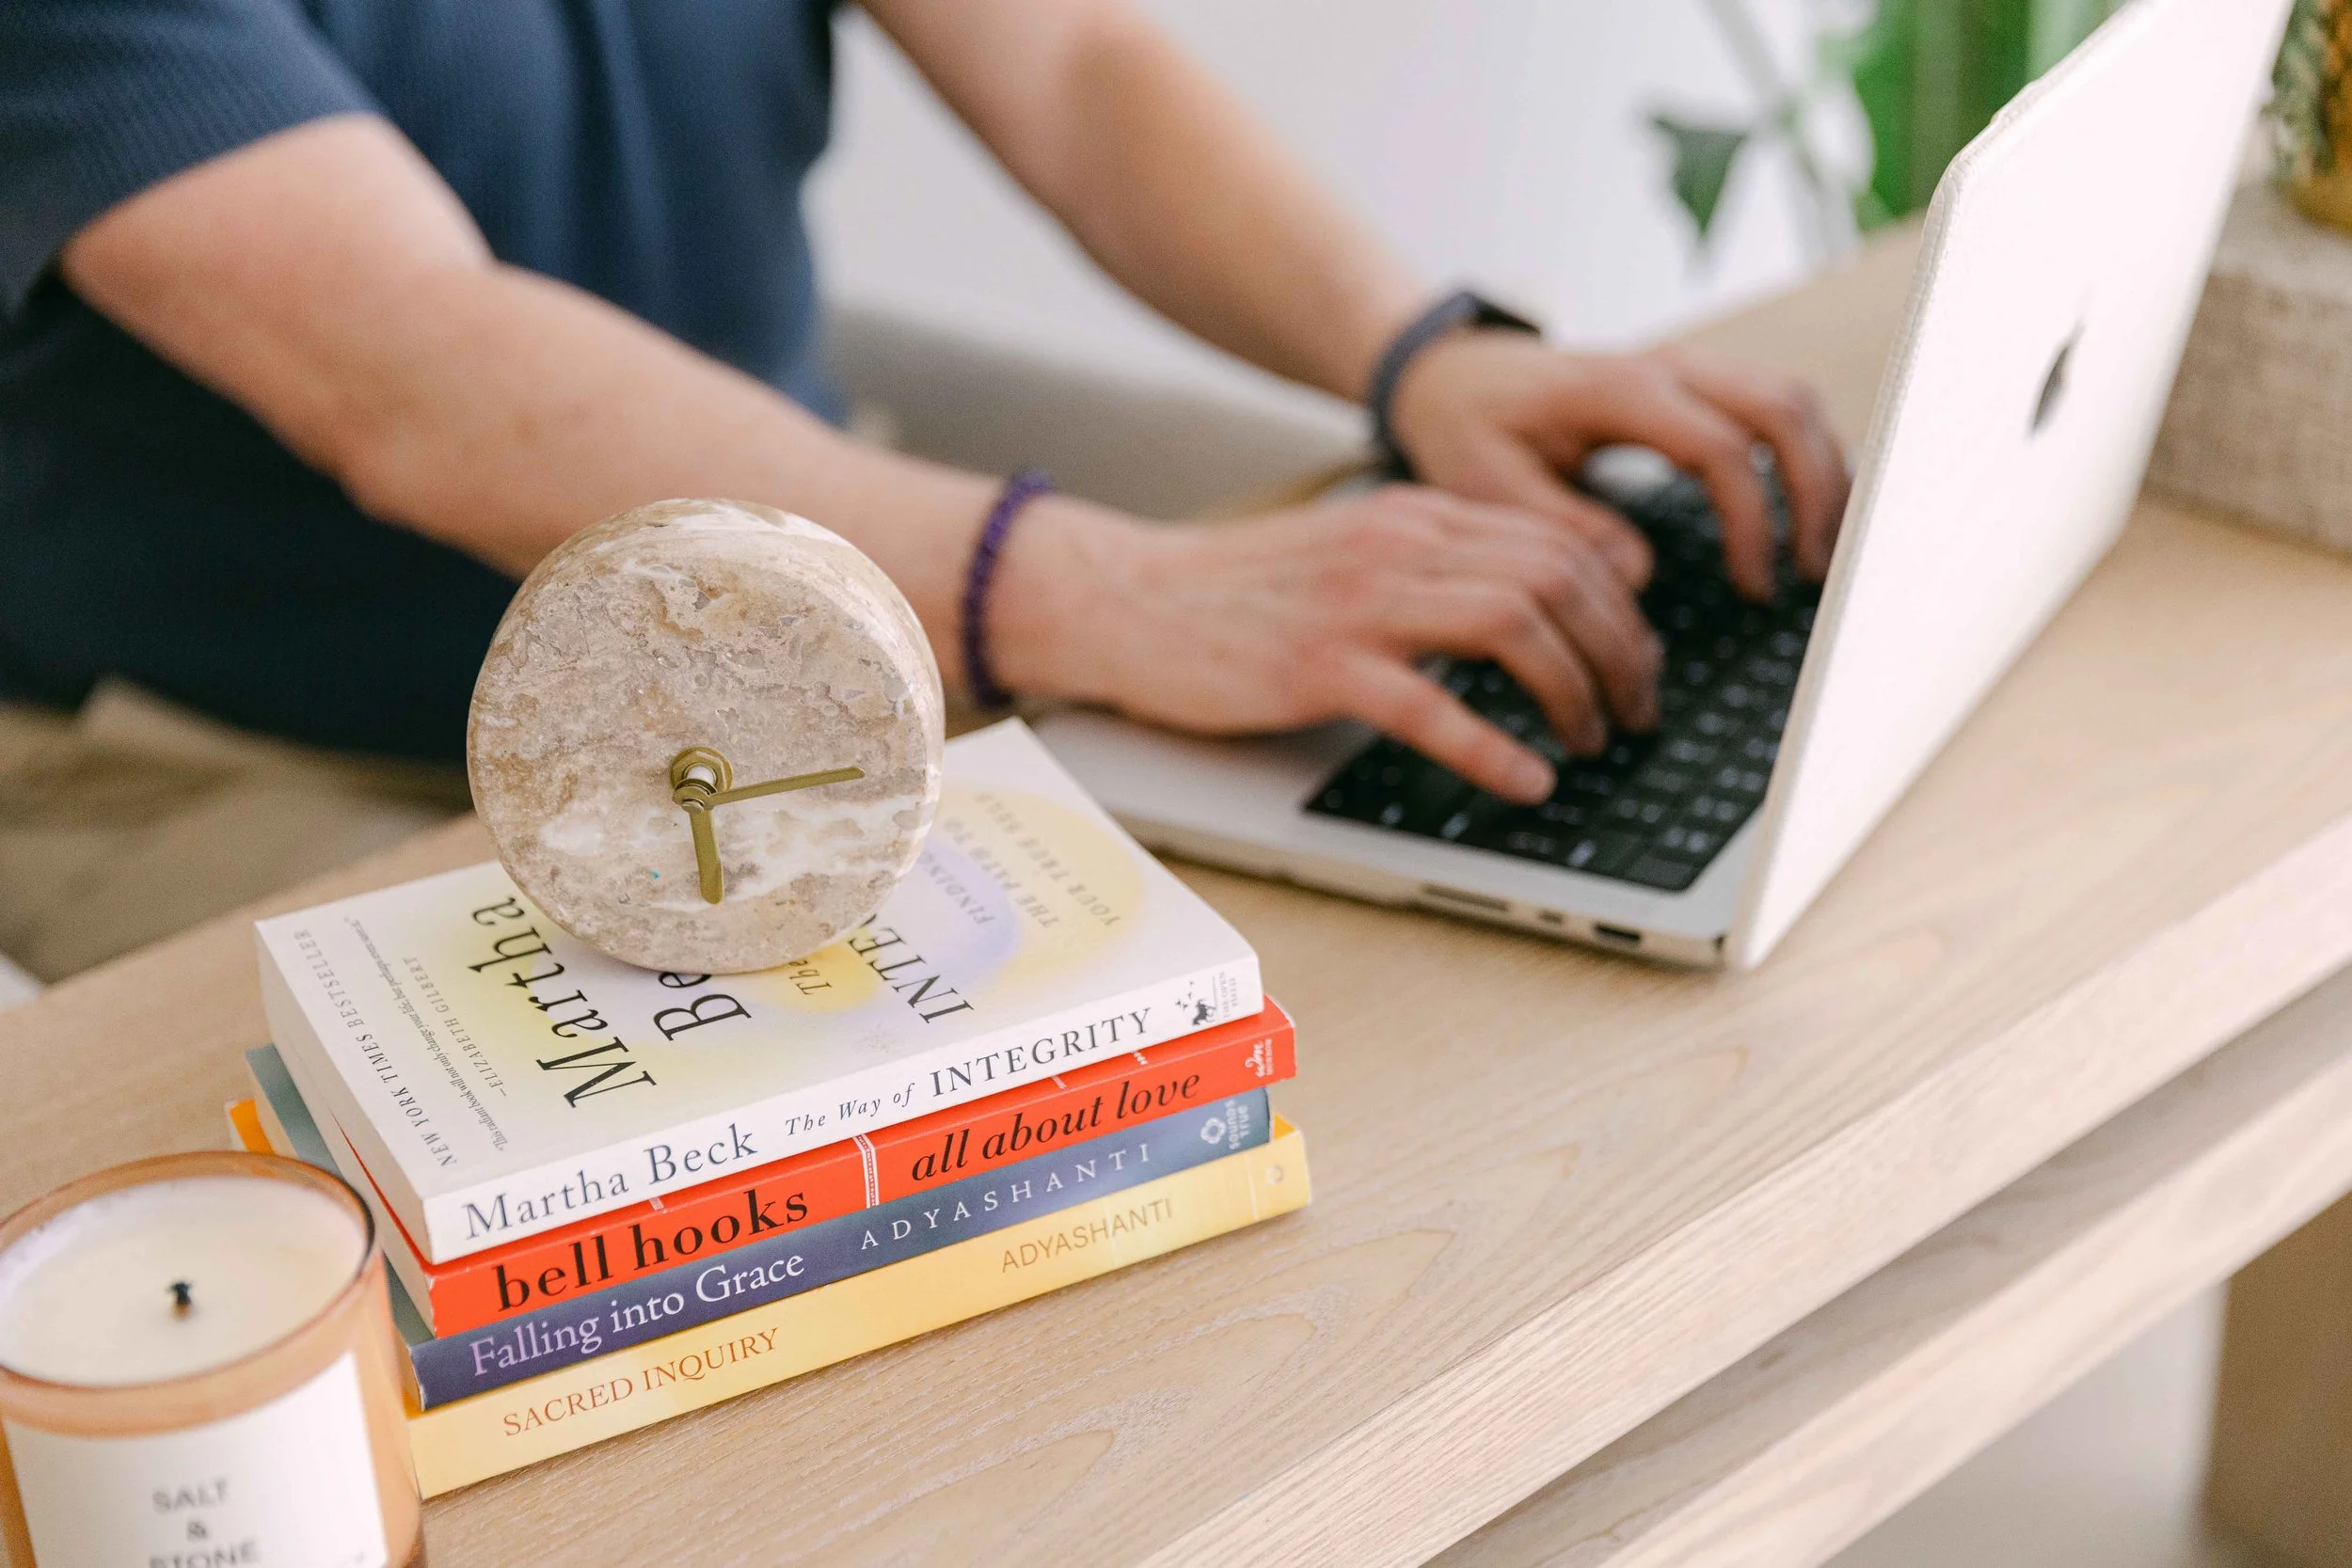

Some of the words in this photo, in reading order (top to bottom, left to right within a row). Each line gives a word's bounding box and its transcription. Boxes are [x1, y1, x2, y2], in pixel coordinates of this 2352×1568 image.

[1016, 895, 1058, 927] THE
[1067, 884, 1120, 926] YOUR
[294, 929, 365, 1028] BESTSELLER
[403, 957, 449, 1013] GILBERT
[468, 896, 658, 1108] Martha
[653, 972, 753, 1041] Be
[358, 1033, 399, 1084] TIMES
[421, 1029, 440, 1053] change
[434, 1053, 452, 1068] only
[786, 1114, 827, 1136] The
[837, 1097, 882, 1121] Way
[892, 1081, 917, 1109] of
[929, 1006, 1152, 1099] INTEGRITY
[390, 1086, 430, 1128] YORK
[450, 1078, 468, 1091] will
[460, 1090, 481, 1109] book
[421, 1132, 458, 1166] NEW
[912, 1129, 970, 1181] all
[983, 1096, 1101, 1164] about
[1118, 1080, 1200, 1116] love
[461, 1169, 629, 1241] Martha
[644, 1122, 758, 1185] Beck
[861, 1143, 1151, 1250] ADYASHANTI
[492, 1234, 613, 1313] bell
[633, 1189, 809, 1271] hooks
[1002, 1197, 1172, 1273] ADYASHANTI
[469, 1317, 602, 1376] Falling
[610, 1291, 684, 1334] into
[694, 1254, 805, 1302] Grace
[503, 1376, 634, 1436] SACRED
[644, 1326, 780, 1390] INQUIRY
[151, 1479, 228, 1513] SALT
